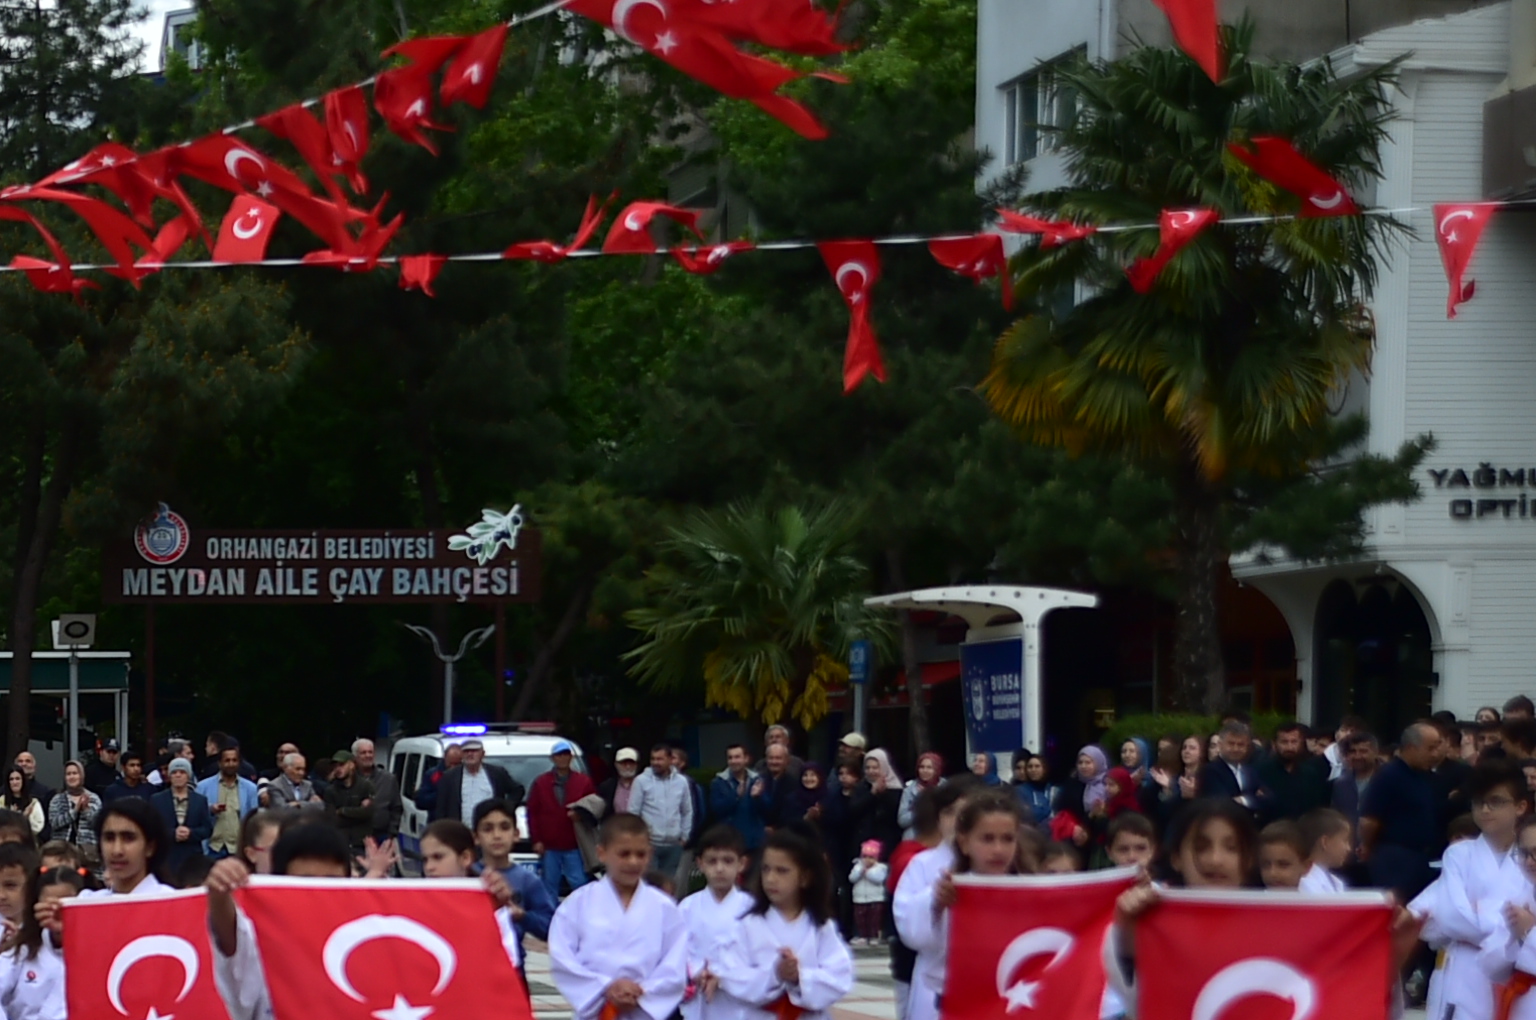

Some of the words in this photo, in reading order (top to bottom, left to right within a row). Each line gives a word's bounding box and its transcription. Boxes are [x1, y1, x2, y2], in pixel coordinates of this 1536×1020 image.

[206, 532, 318, 560] ORHANGAZİ
[324, 532, 435, 560] BELEDİYESİ
[122, 568, 245, 596] MEYDAN
[255, 561, 318, 596] AİLE
[329, 568, 384, 603] ÇAY
[392, 561, 519, 603] BAHÇESİ
[991, 674, 1019, 691] BURSA
